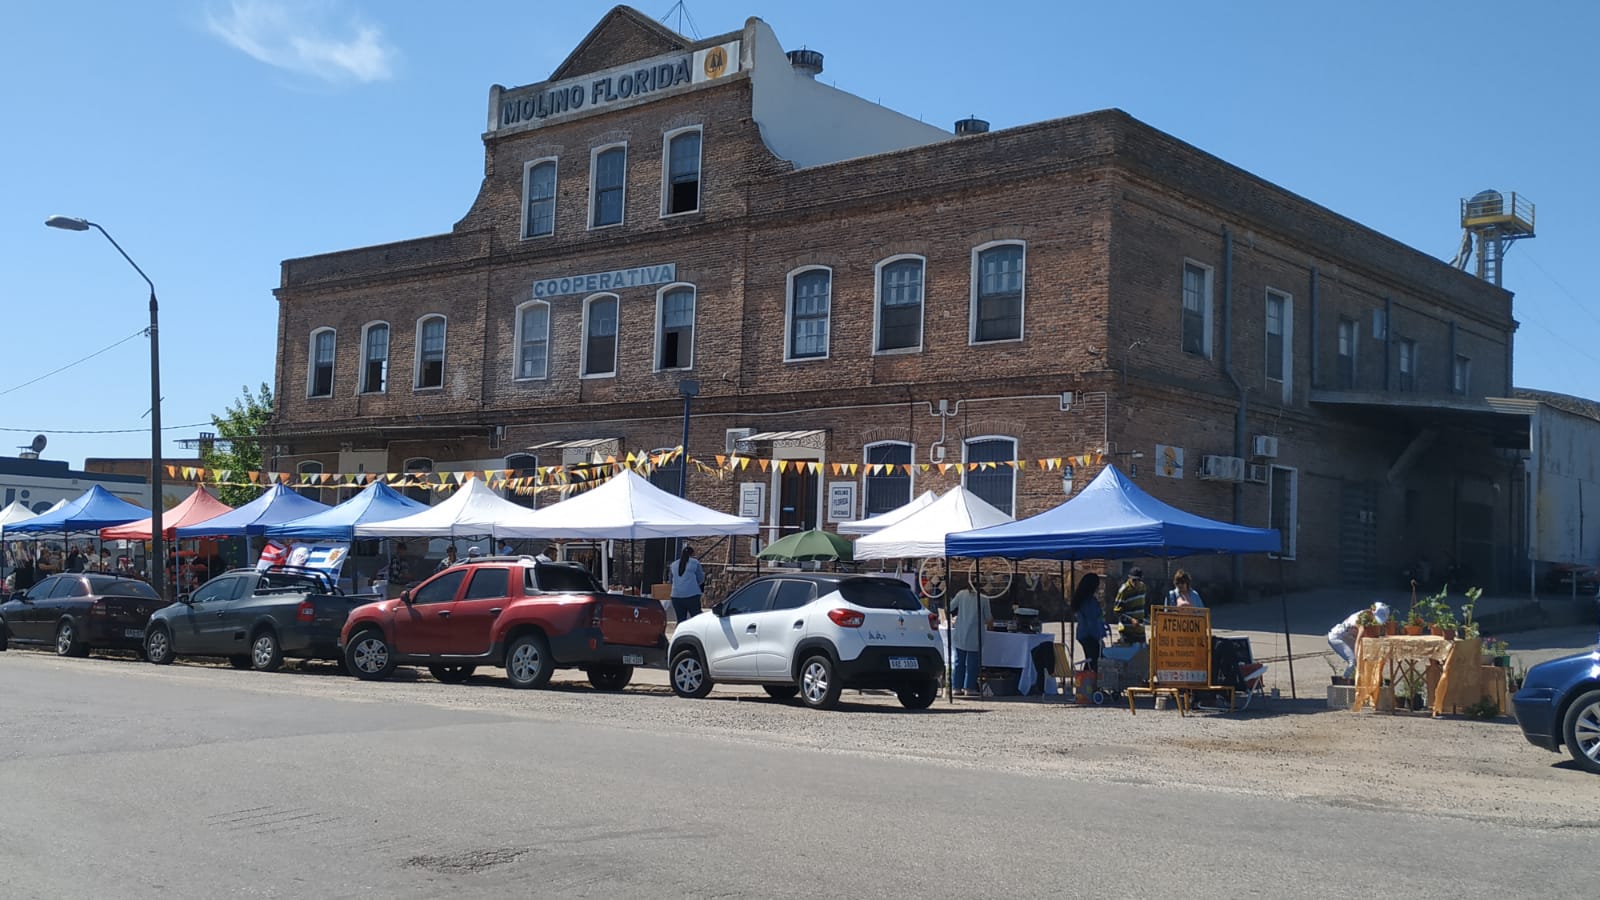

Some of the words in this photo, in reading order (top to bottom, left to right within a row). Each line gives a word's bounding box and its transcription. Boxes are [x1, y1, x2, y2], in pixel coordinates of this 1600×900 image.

[503, 84, 585, 125] MOLINO
[591, 59, 690, 105] FLORIDA
[534, 265, 673, 297] COOPERATIVA
[1162, 619, 1200, 632] ATENCION
